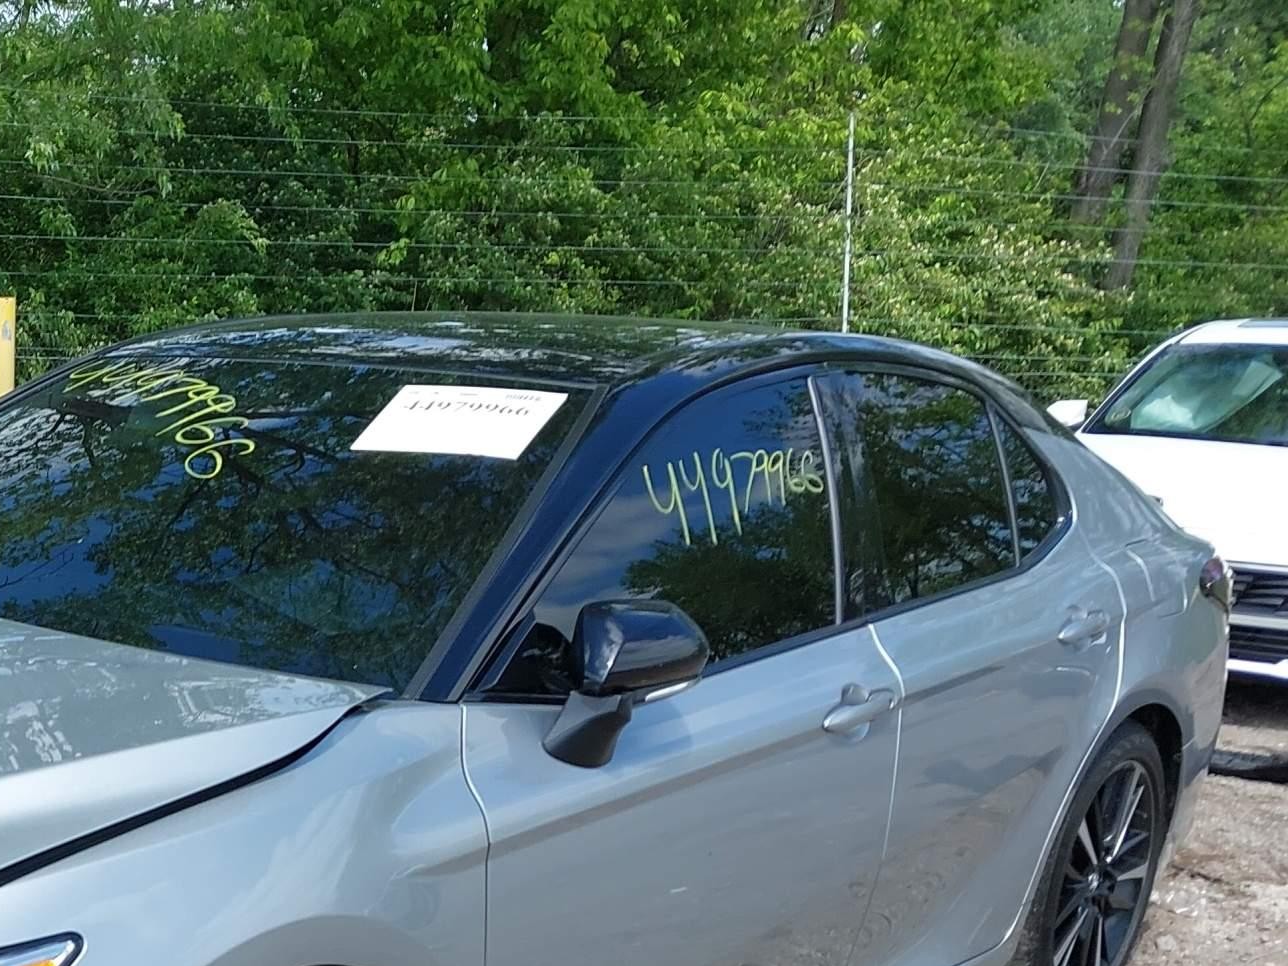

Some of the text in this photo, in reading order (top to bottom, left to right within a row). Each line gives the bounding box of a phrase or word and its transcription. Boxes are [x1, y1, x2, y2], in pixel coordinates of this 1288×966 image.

[62, 358, 256, 479] 44979966
[403, 399, 530, 417] 44979966
[642, 447, 824, 546] 44979966
